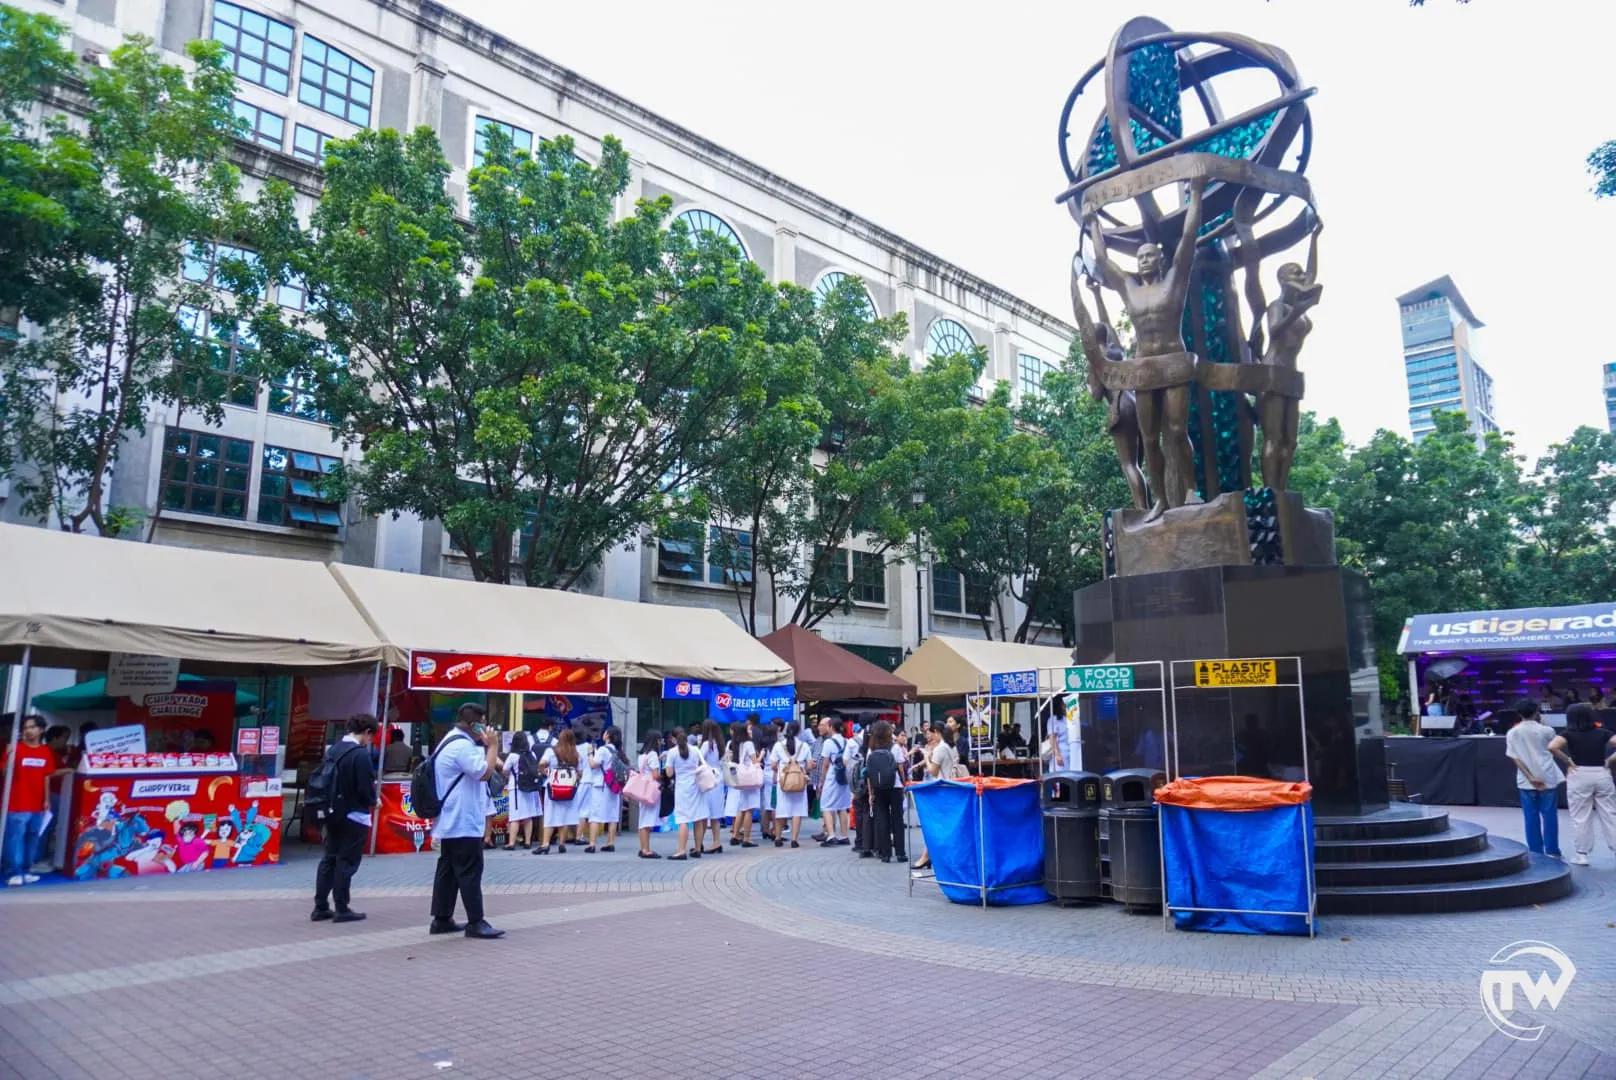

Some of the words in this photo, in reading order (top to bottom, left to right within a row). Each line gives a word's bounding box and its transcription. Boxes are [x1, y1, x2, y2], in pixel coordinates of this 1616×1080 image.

[1510, 634, 1551, 642] WHERE
[1212, 662, 1272, 673] PLASTIC
[1084, 667, 1130, 679] FOOD
[1085, 679, 1130, 688] WASTE
[756, 698, 768, 707] ARE
[770, 698, 790, 707] HERE
